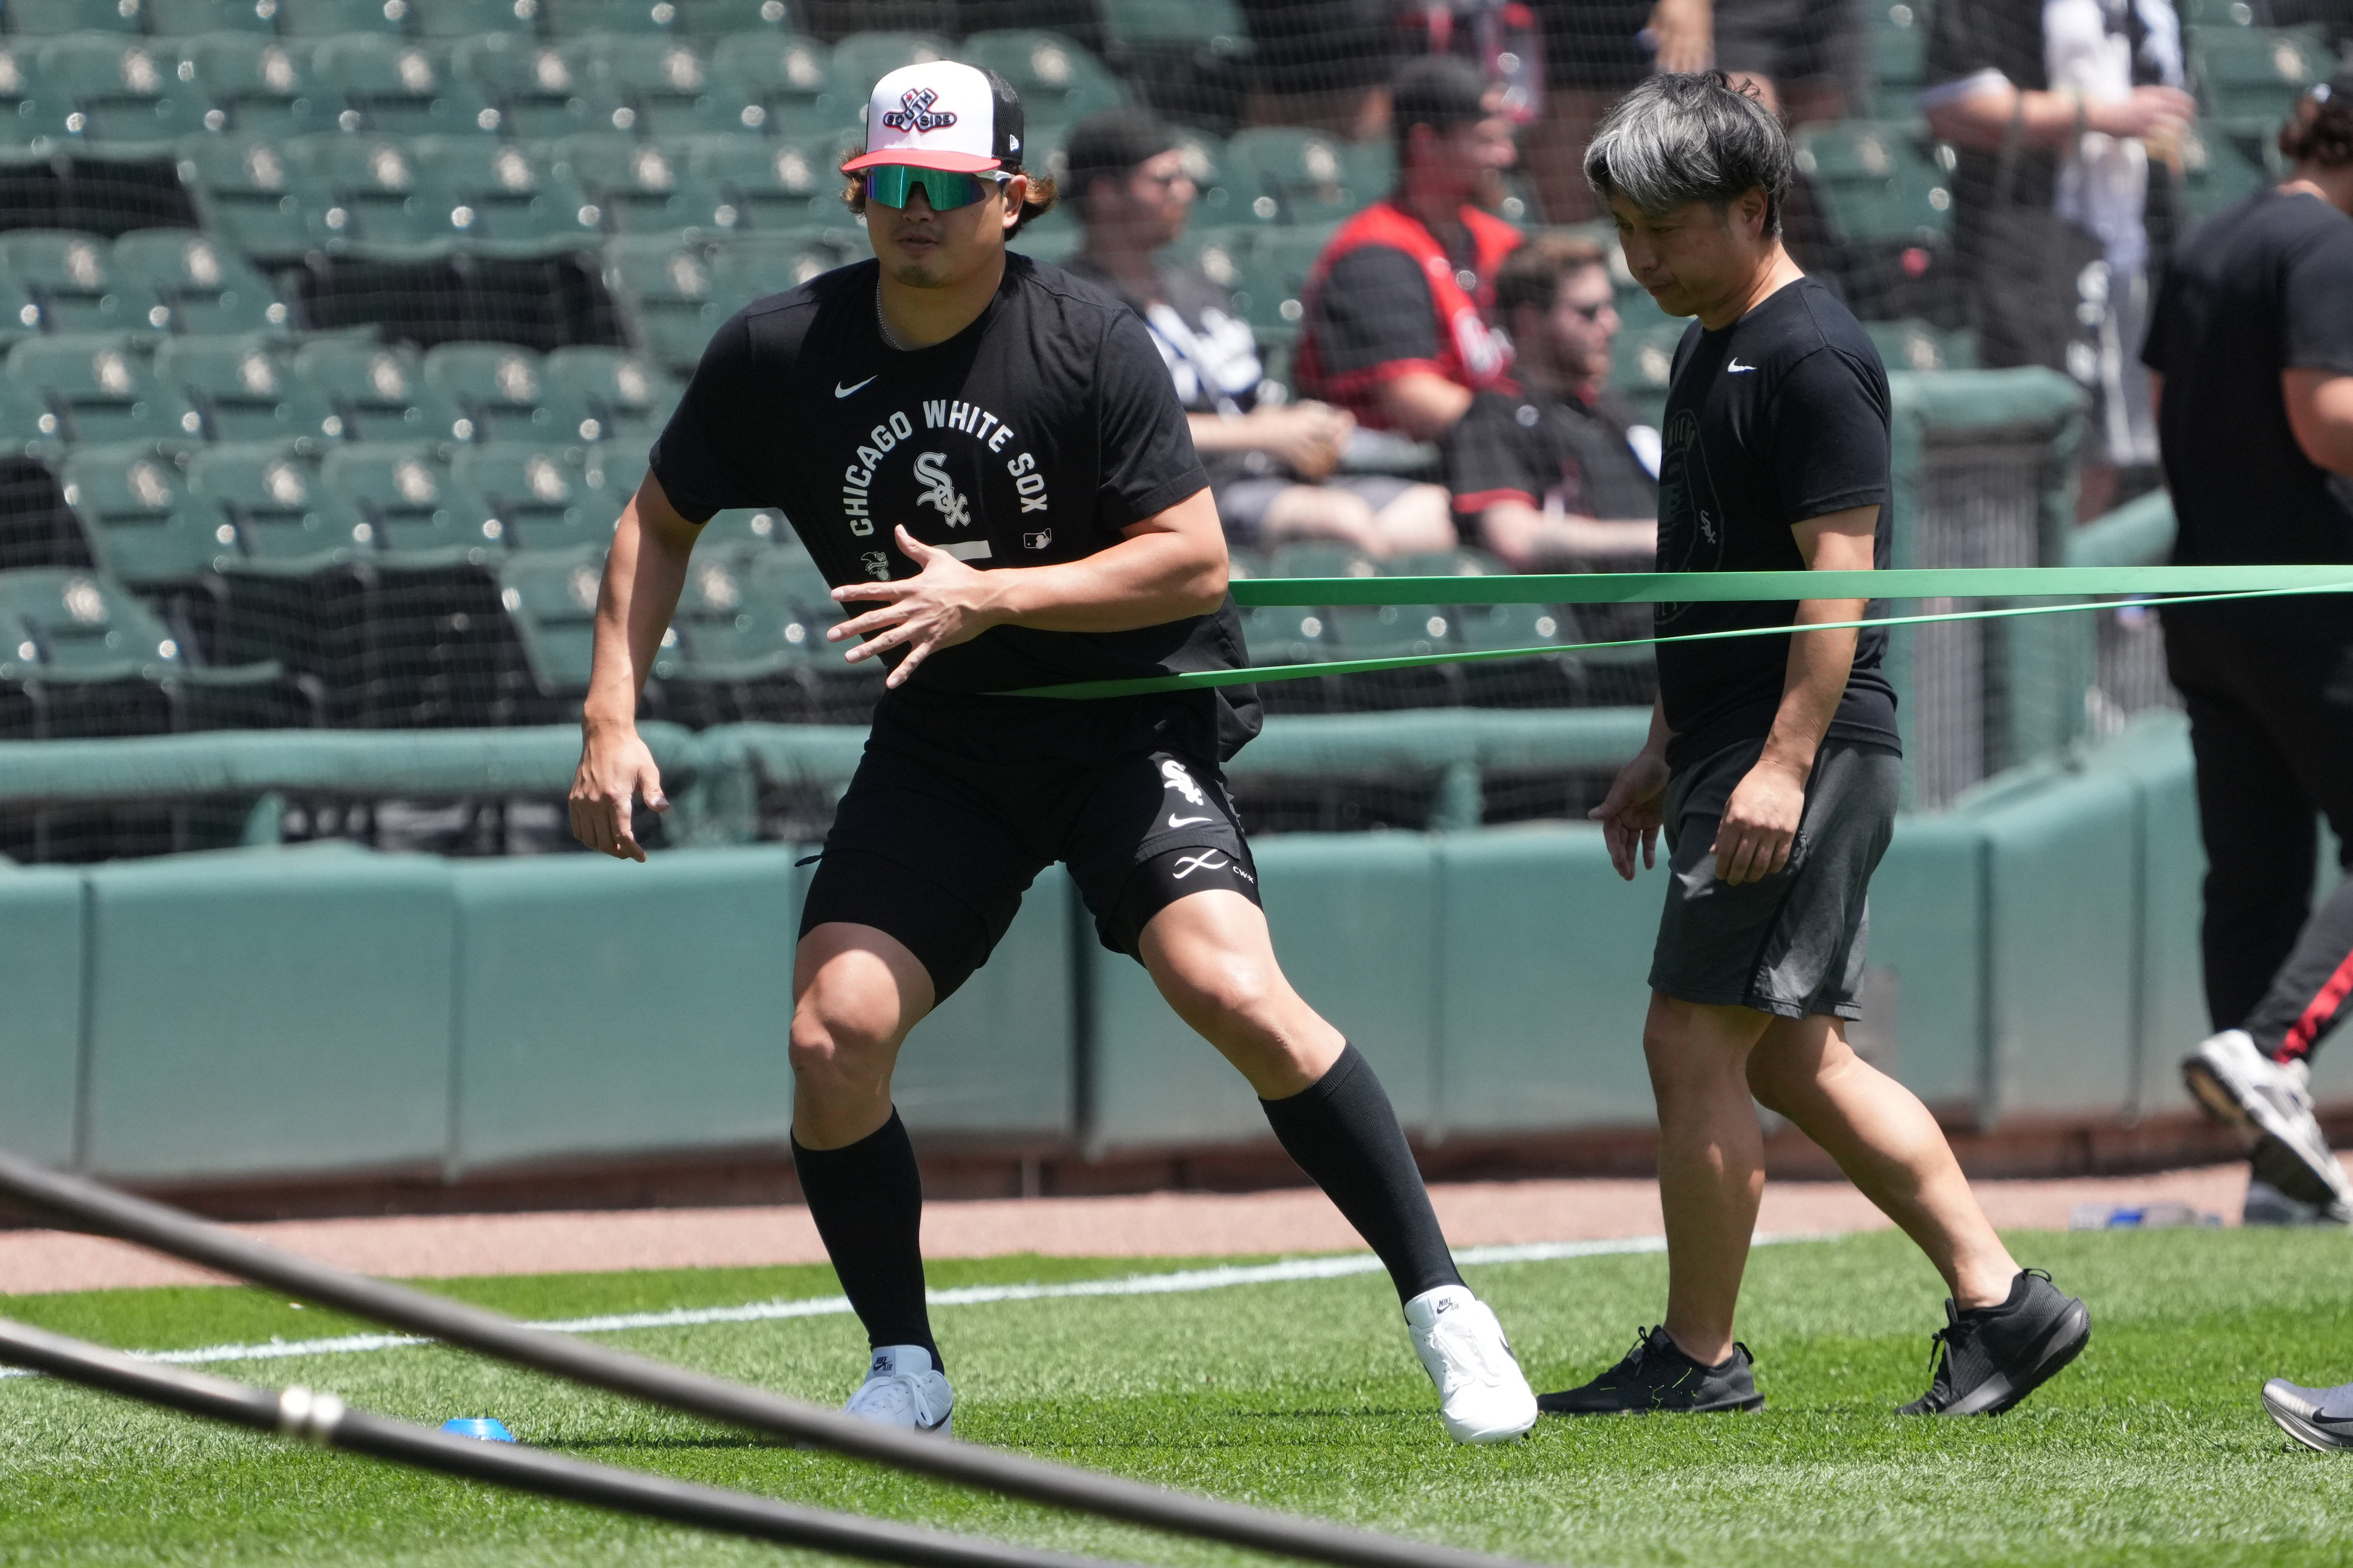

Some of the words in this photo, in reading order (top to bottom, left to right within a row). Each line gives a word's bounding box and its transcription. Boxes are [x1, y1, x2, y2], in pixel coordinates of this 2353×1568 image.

[887, 91, 932, 124] SOUTH
[919, 114, 950, 127] SIDE
[843, 411, 913, 537] CHICAGO
[922, 399, 1014, 453] WHITE
[1007, 452, 1048, 513] SOX
[1233, 866, 1254, 884] CW-X
[1439, 1297, 1452, 1308] NIKE
[1451, 1303, 1460, 1311] AIR
[877, 1356, 887, 1364] NIKE
[882, 1363, 893, 1372] AIR
